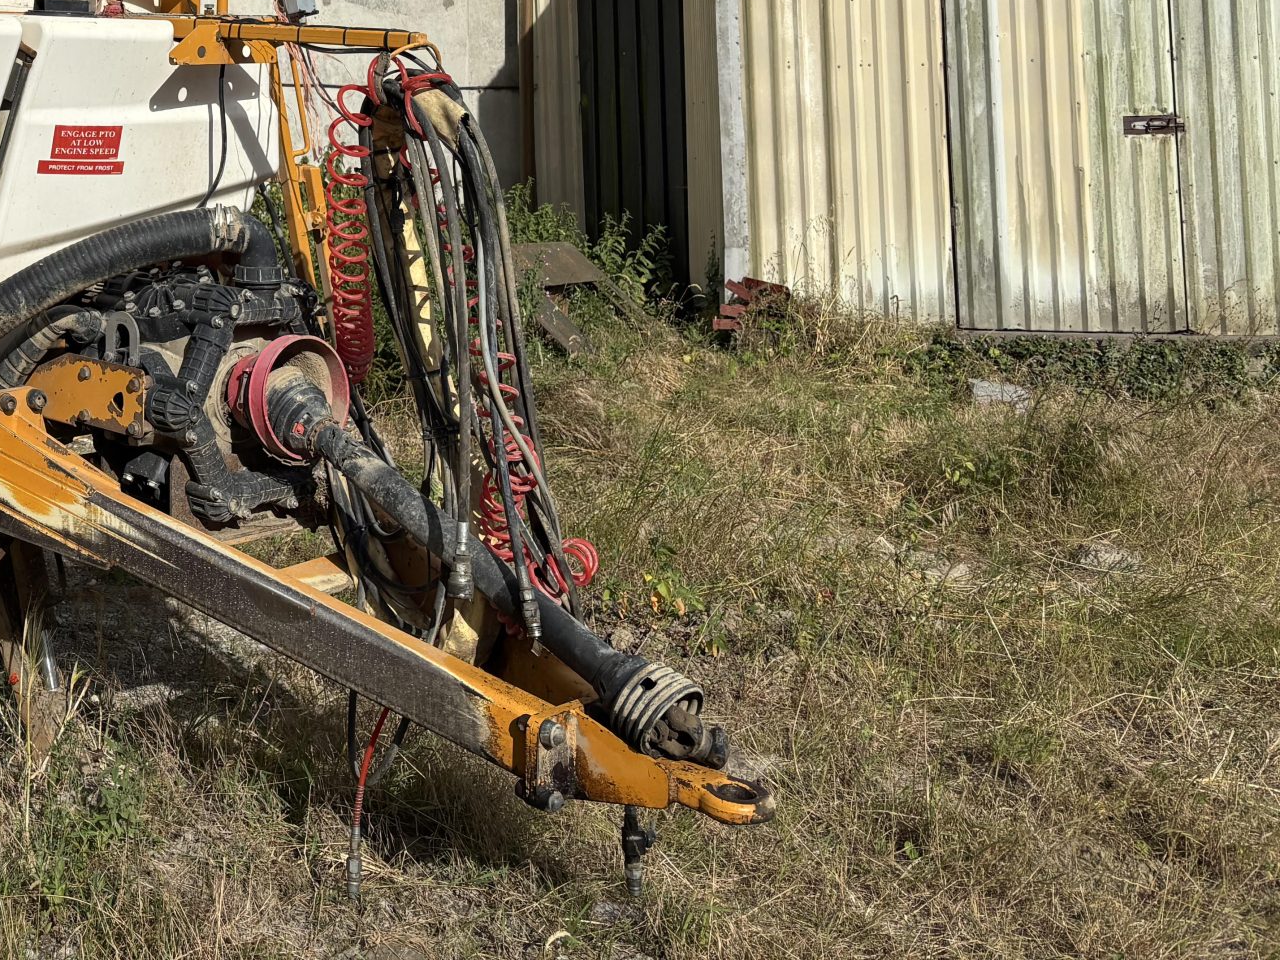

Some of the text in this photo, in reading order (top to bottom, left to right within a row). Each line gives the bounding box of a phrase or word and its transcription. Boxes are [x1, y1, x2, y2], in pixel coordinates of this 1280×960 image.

[61, 130, 97, 138] ENGAGE
[70, 139, 104, 147] AT LOW
[55, 147, 116, 155] ENGINE SPEED
